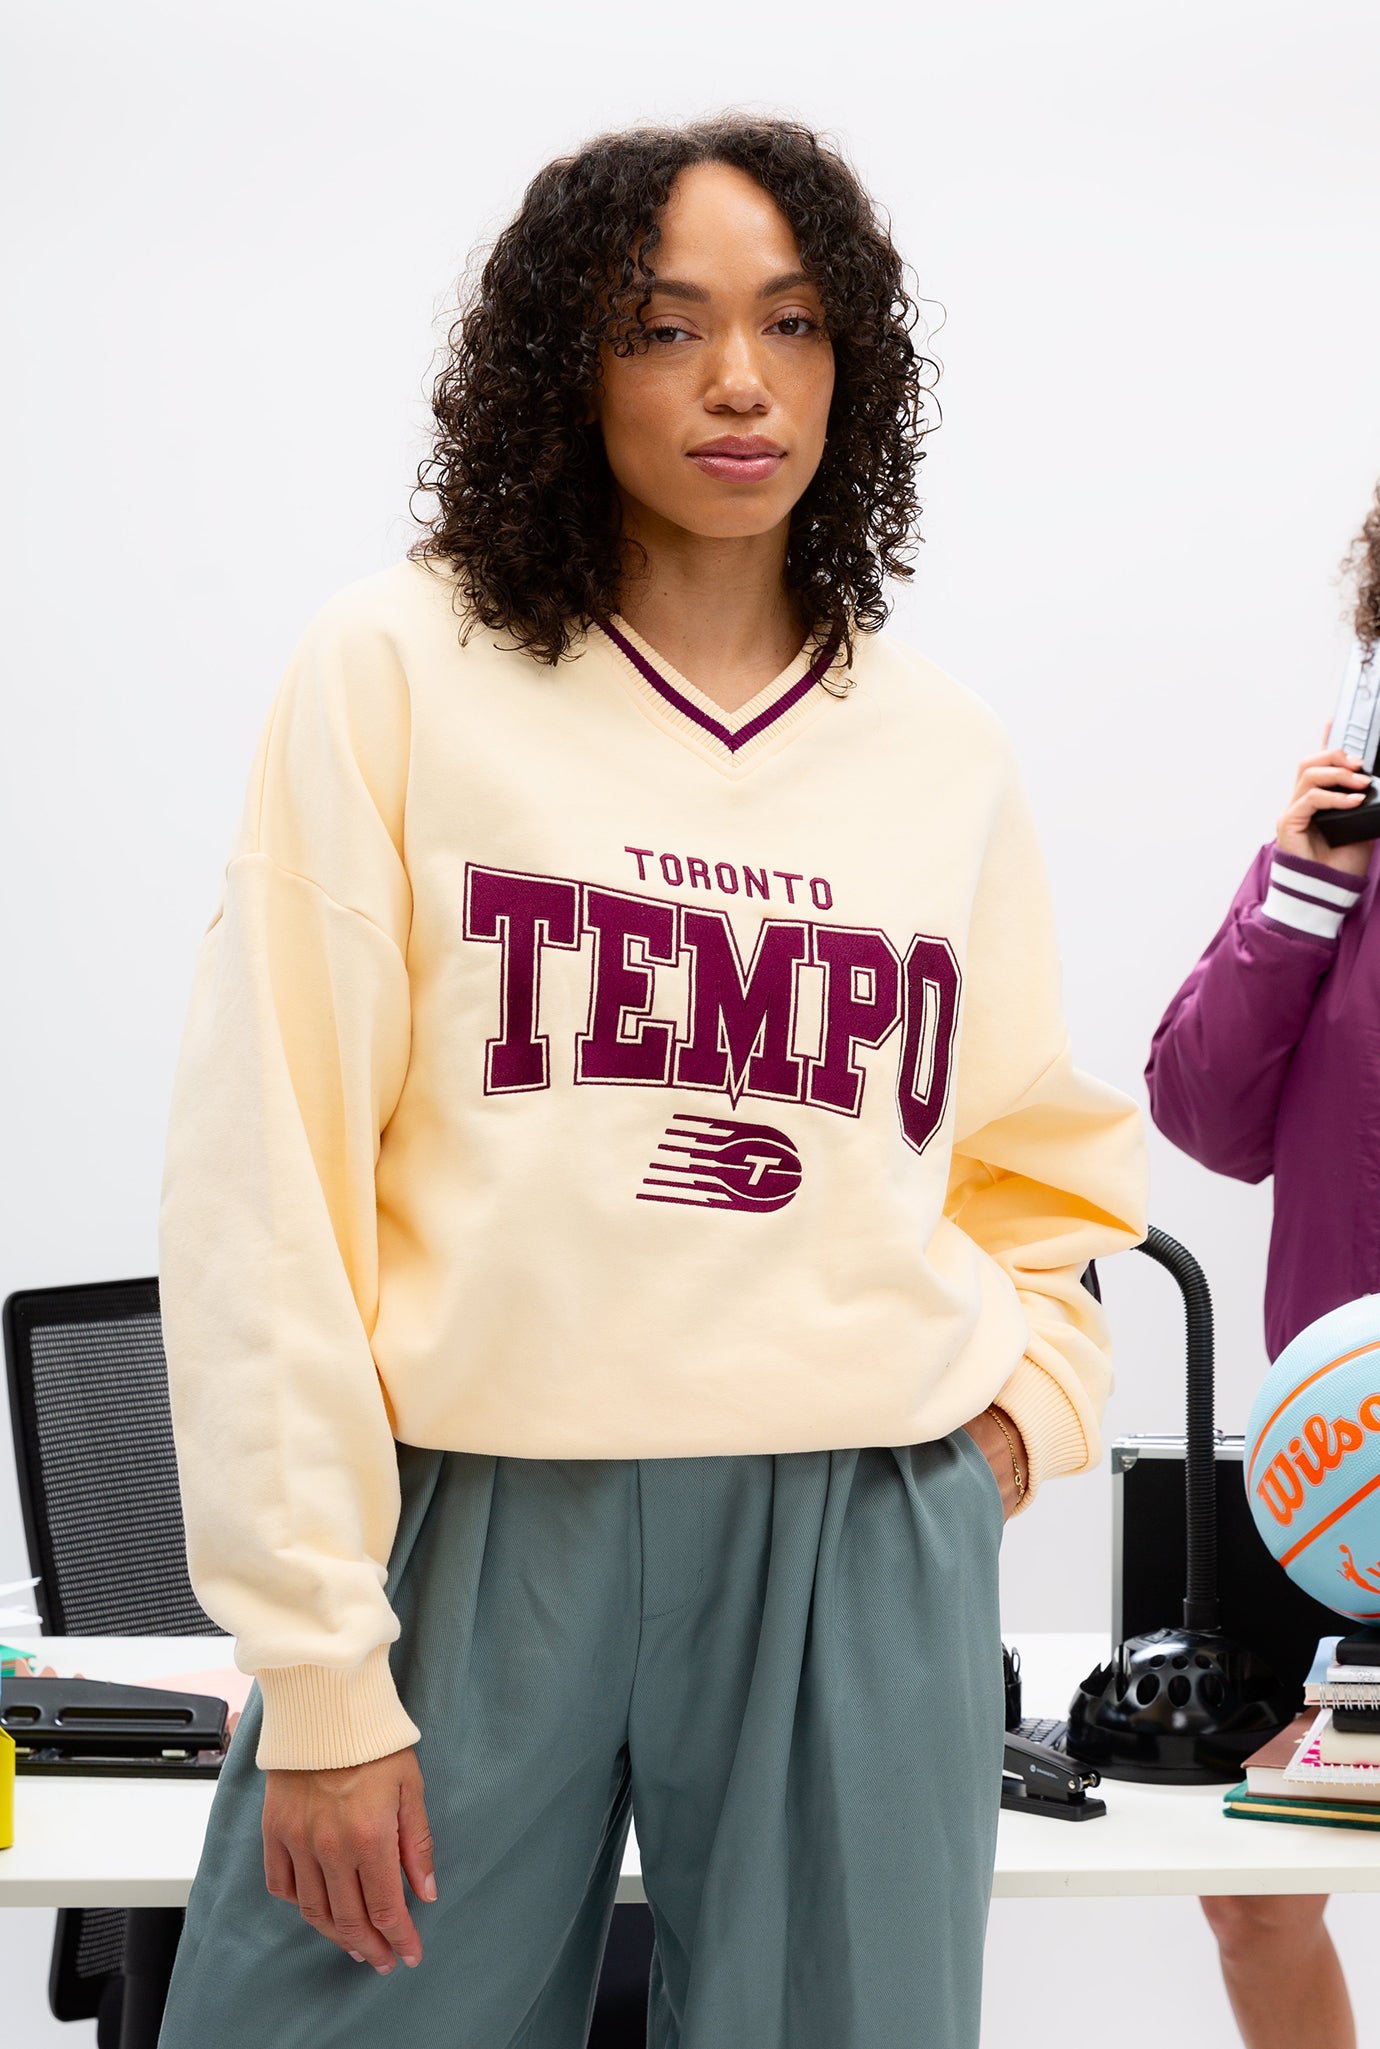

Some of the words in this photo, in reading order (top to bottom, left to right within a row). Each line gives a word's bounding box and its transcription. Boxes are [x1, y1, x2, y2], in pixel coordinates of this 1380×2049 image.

[624, 846, 833, 910] TORONTO
[463, 862, 962, 1155] TEMPO
[743, 1154, 782, 1186] T
